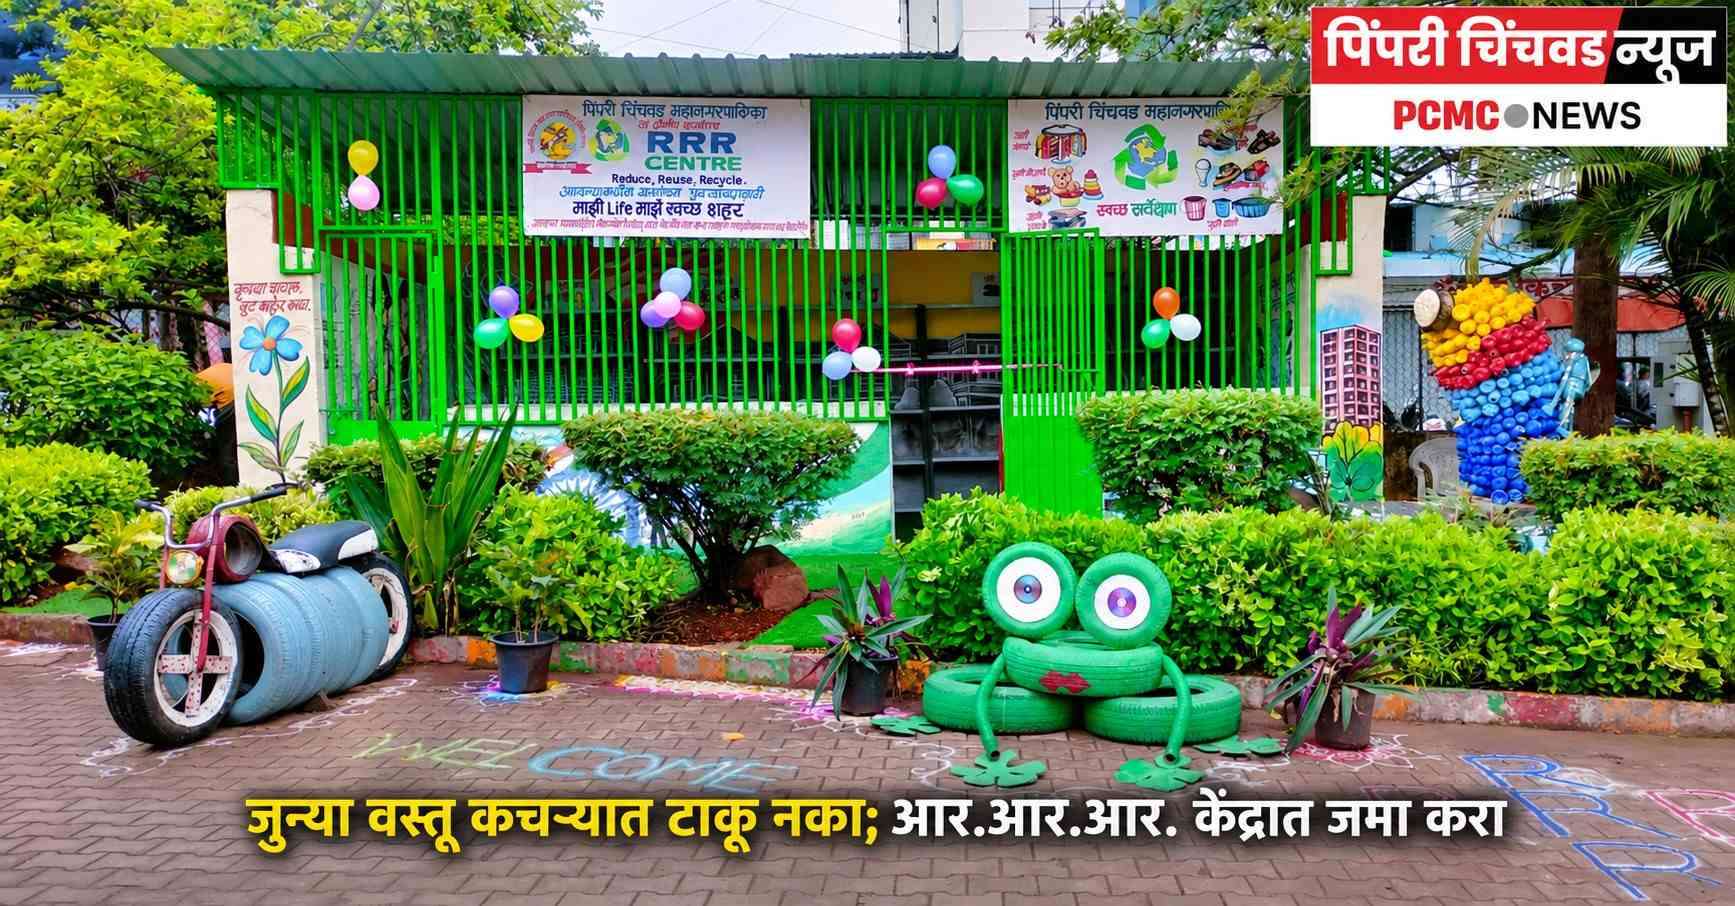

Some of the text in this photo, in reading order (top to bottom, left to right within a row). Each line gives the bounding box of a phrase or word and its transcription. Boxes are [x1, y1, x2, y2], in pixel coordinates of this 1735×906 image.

[583, 99, 616, 118] पिंपरी
[621, 99, 666, 119] चिंचवड
[1045, 101, 1084, 120] पिंपरी
[1088, 101, 1140, 120] चिंचवड
[647, 131, 737, 154] RRR
[645, 156, 742, 171] CENTRE
[612, 173, 655, 186] Reduce,
[700, 175, 748, 188] Recycle.
[573, 197, 604, 217] माझी
[608, 201, 632, 215] Life
[665, 202, 703, 217] स्वच्छ
[707, 203, 744, 221] शहर
[1096, 204, 1129, 217] स्वच्छ
